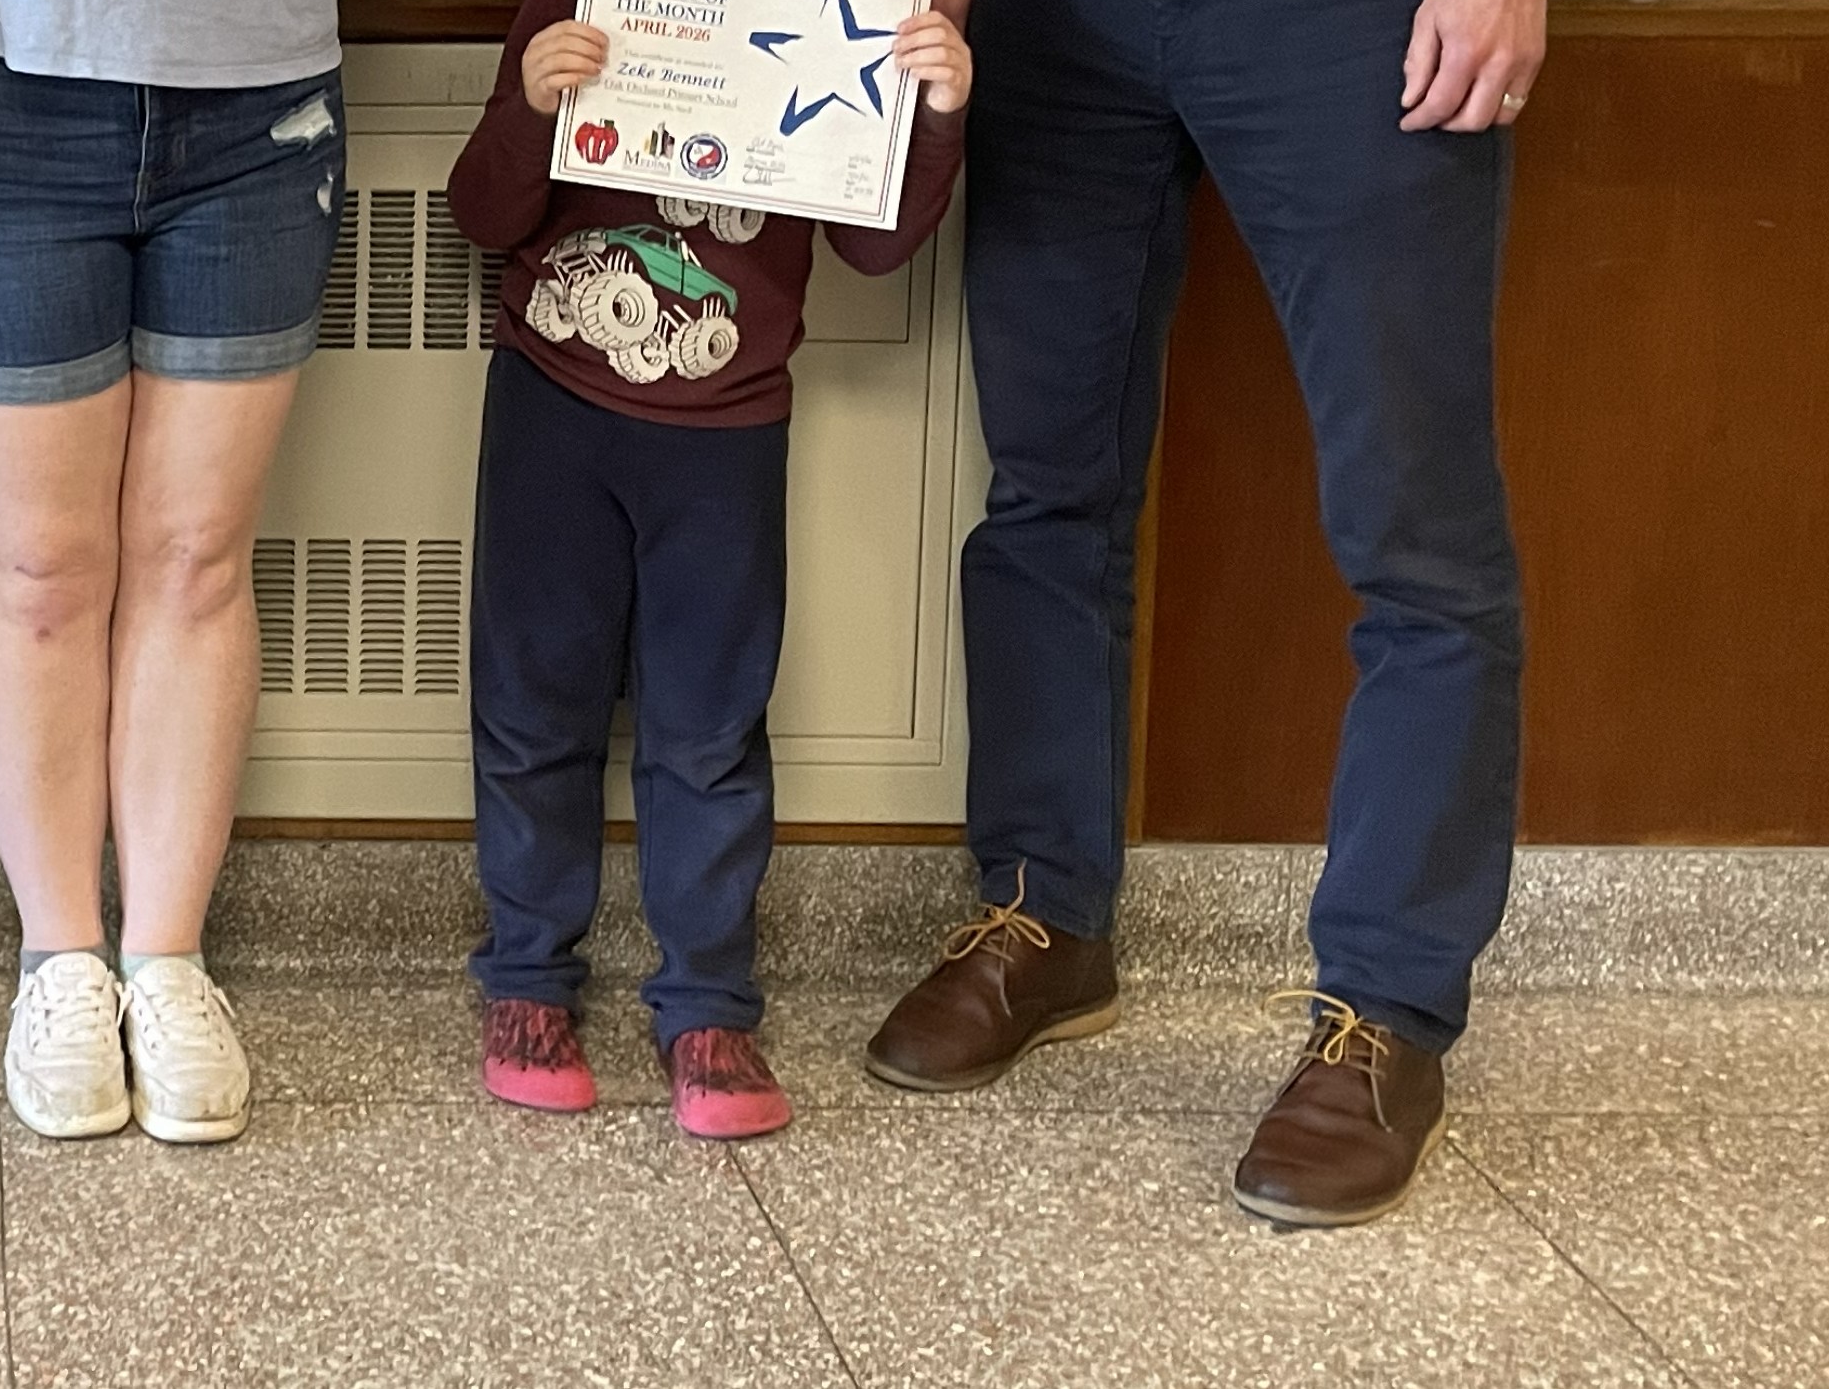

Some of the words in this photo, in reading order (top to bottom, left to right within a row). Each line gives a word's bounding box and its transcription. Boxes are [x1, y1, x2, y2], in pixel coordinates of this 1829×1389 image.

[654, 1, 725, 25] MONTH
[620, 16, 672, 37] APRIL
[675, 24, 712, 43] 2026
[617, 62, 655, 79] Zeke
[660, 67, 727, 90] Bennett
